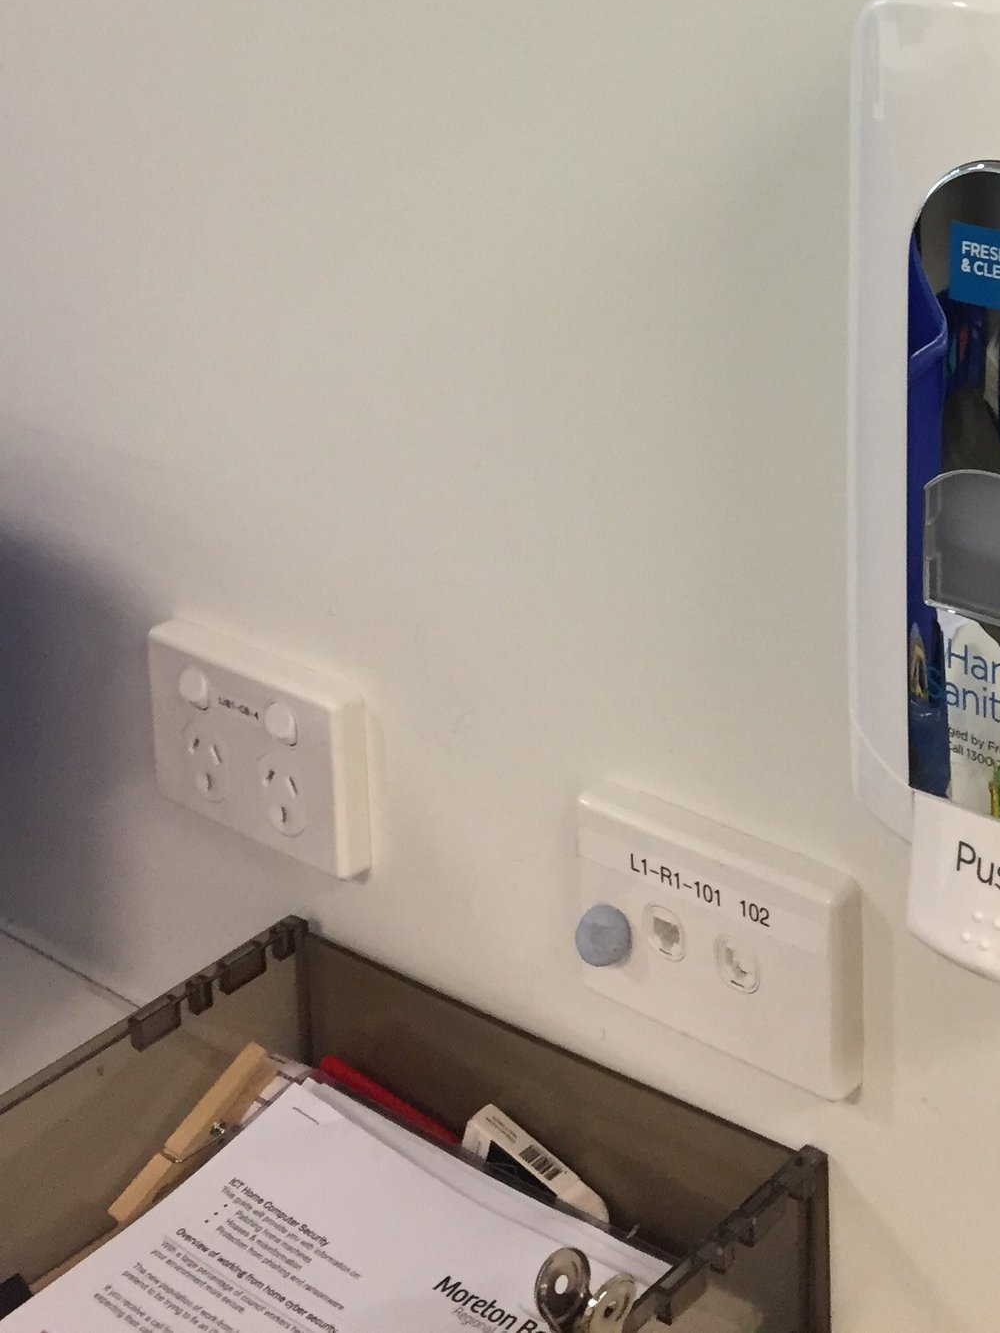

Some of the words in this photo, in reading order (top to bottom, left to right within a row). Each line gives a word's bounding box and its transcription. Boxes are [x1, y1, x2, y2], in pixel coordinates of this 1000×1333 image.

[961, 258, 971, 273] &
[971, 734, 984, 749] by
[630, 854, 721, 907] L1-R1-101
[740, 900, 771, 928] 102
[229, 1178, 244, 1189] ICT
[241, 1186, 264, 1205] Home
[263, 1201, 300, 1227] Computer
[299, 1224, 329, 1247] Security
[176, 1228, 209, 1252] Overview
[208, 1250, 220, 1258] of
[217, 1256, 247, 1278] working
[245, 1273, 264, 1289] from
[263, 1285, 286, 1302] home
[285, 1301, 308, 1316] cyber
[432, 1275, 518, 1330] Moreton
